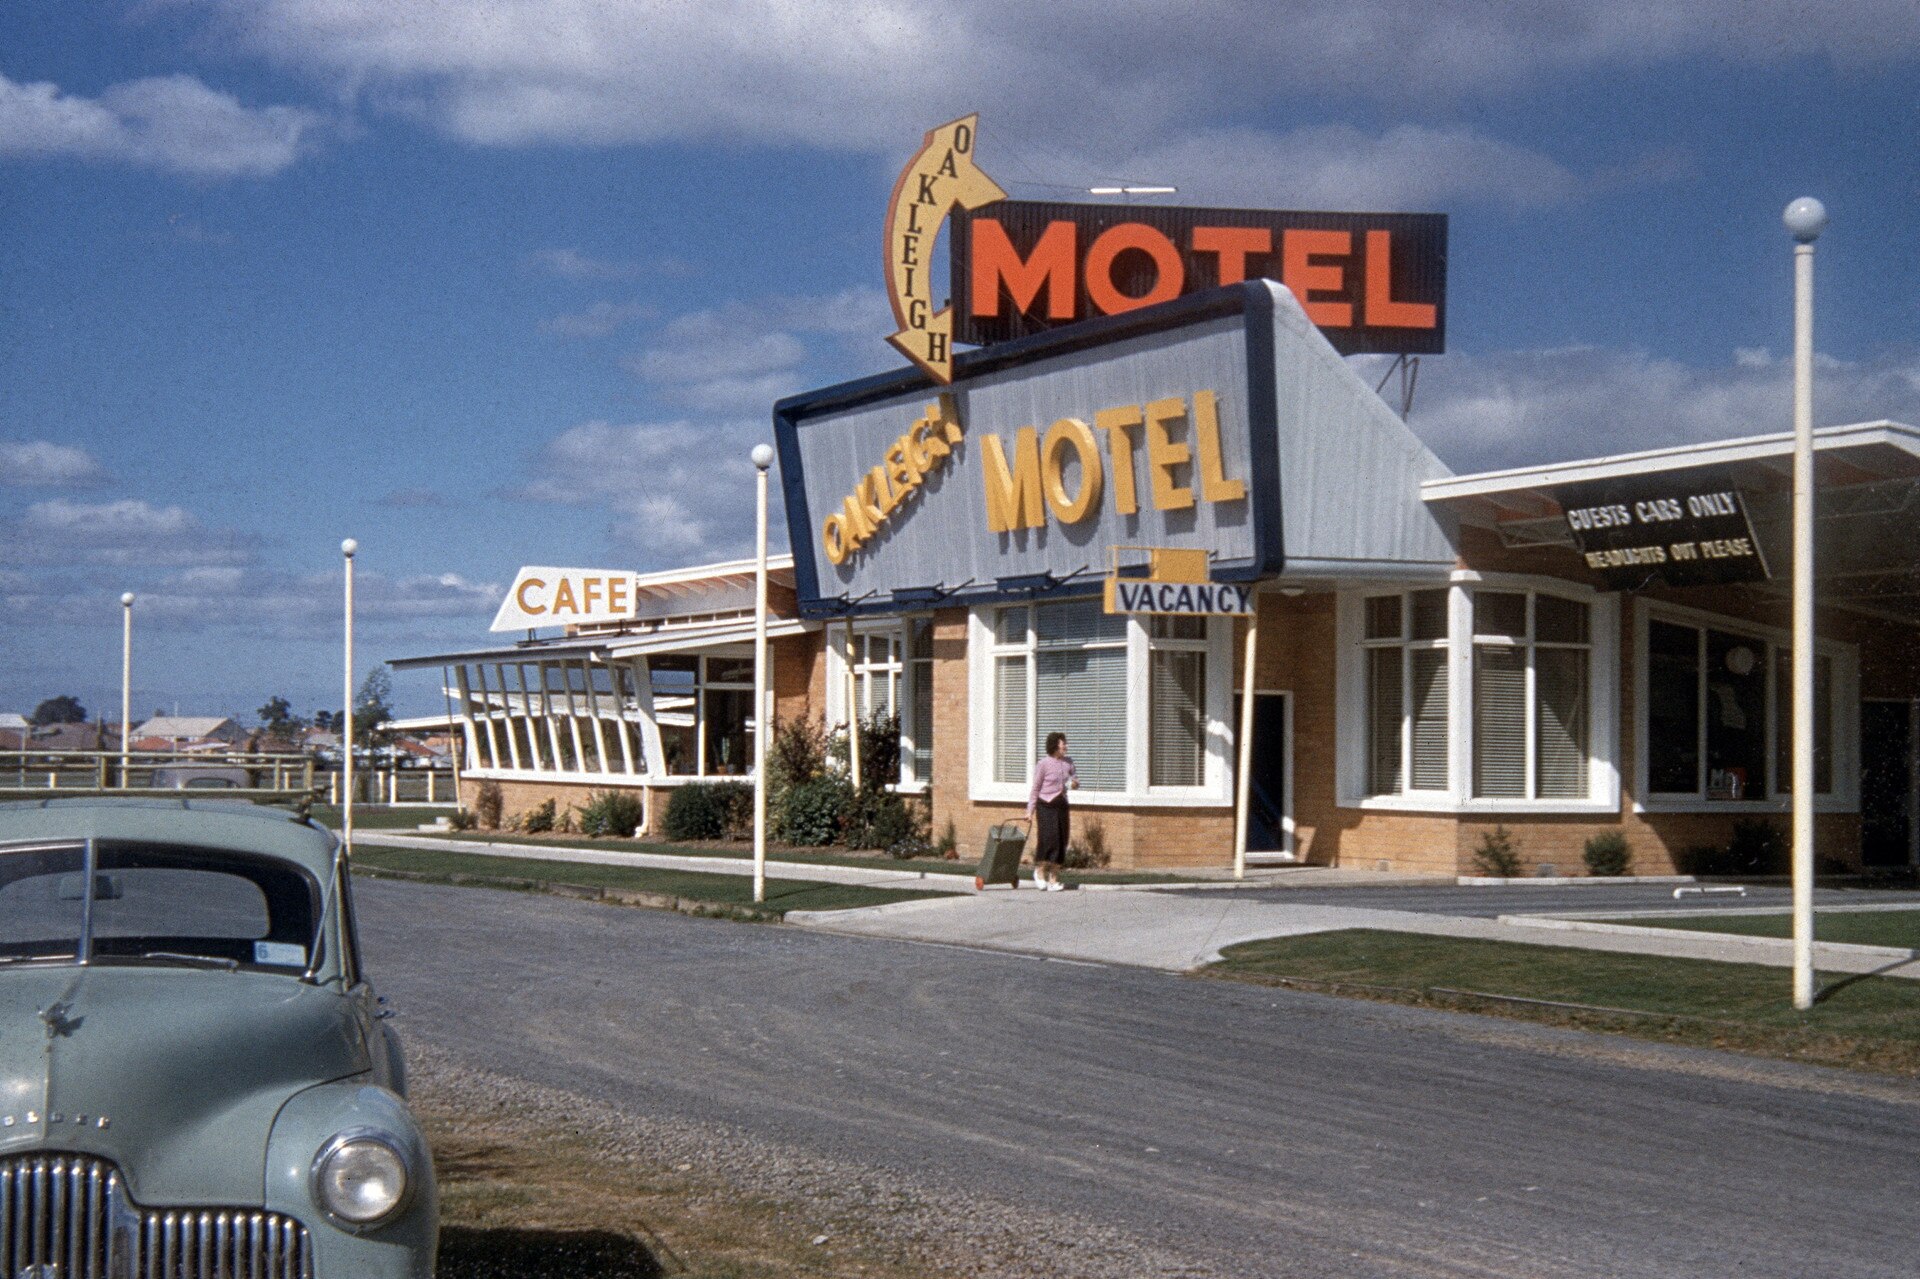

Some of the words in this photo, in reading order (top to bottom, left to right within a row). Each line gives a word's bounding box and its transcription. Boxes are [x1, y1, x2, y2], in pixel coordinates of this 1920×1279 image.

[901, 124, 971, 363] OAKLEIGH
[971, 218, 1437, 328] MOTEL
[980, 390, 1246, 533] MOTEL
[1567, 504, 1632, 530] GUESTS
[1635, 498, 1683, 523] CARS
[1687, 492, 1736, 518] ONLY
[516, 578, 627, 615] CAFE
[1119, 583, 1251, 613] VACANCY
